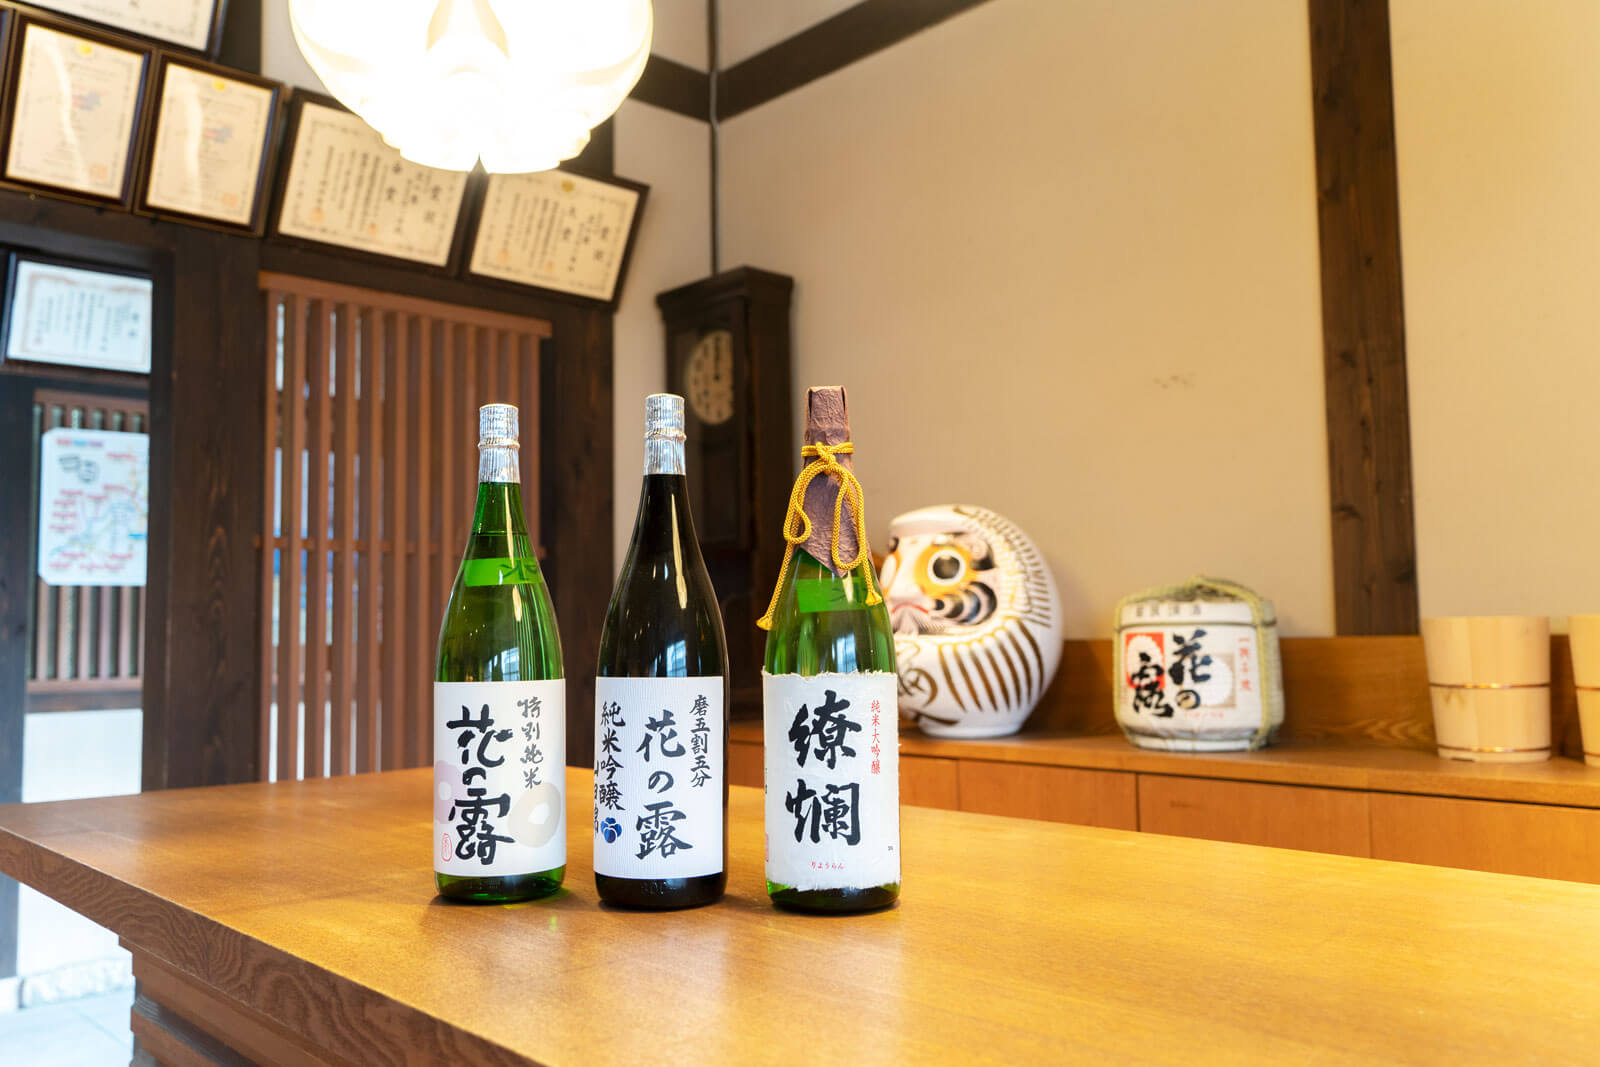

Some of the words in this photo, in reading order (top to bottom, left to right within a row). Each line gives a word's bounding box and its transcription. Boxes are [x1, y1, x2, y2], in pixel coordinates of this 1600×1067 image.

[447, 704, 514, 865] 花の露
[516, 696, 544, 789] 特別純米
[636, 709, 693, 860] 花の露
[689, 694, 712, 787] 磨五割五分
